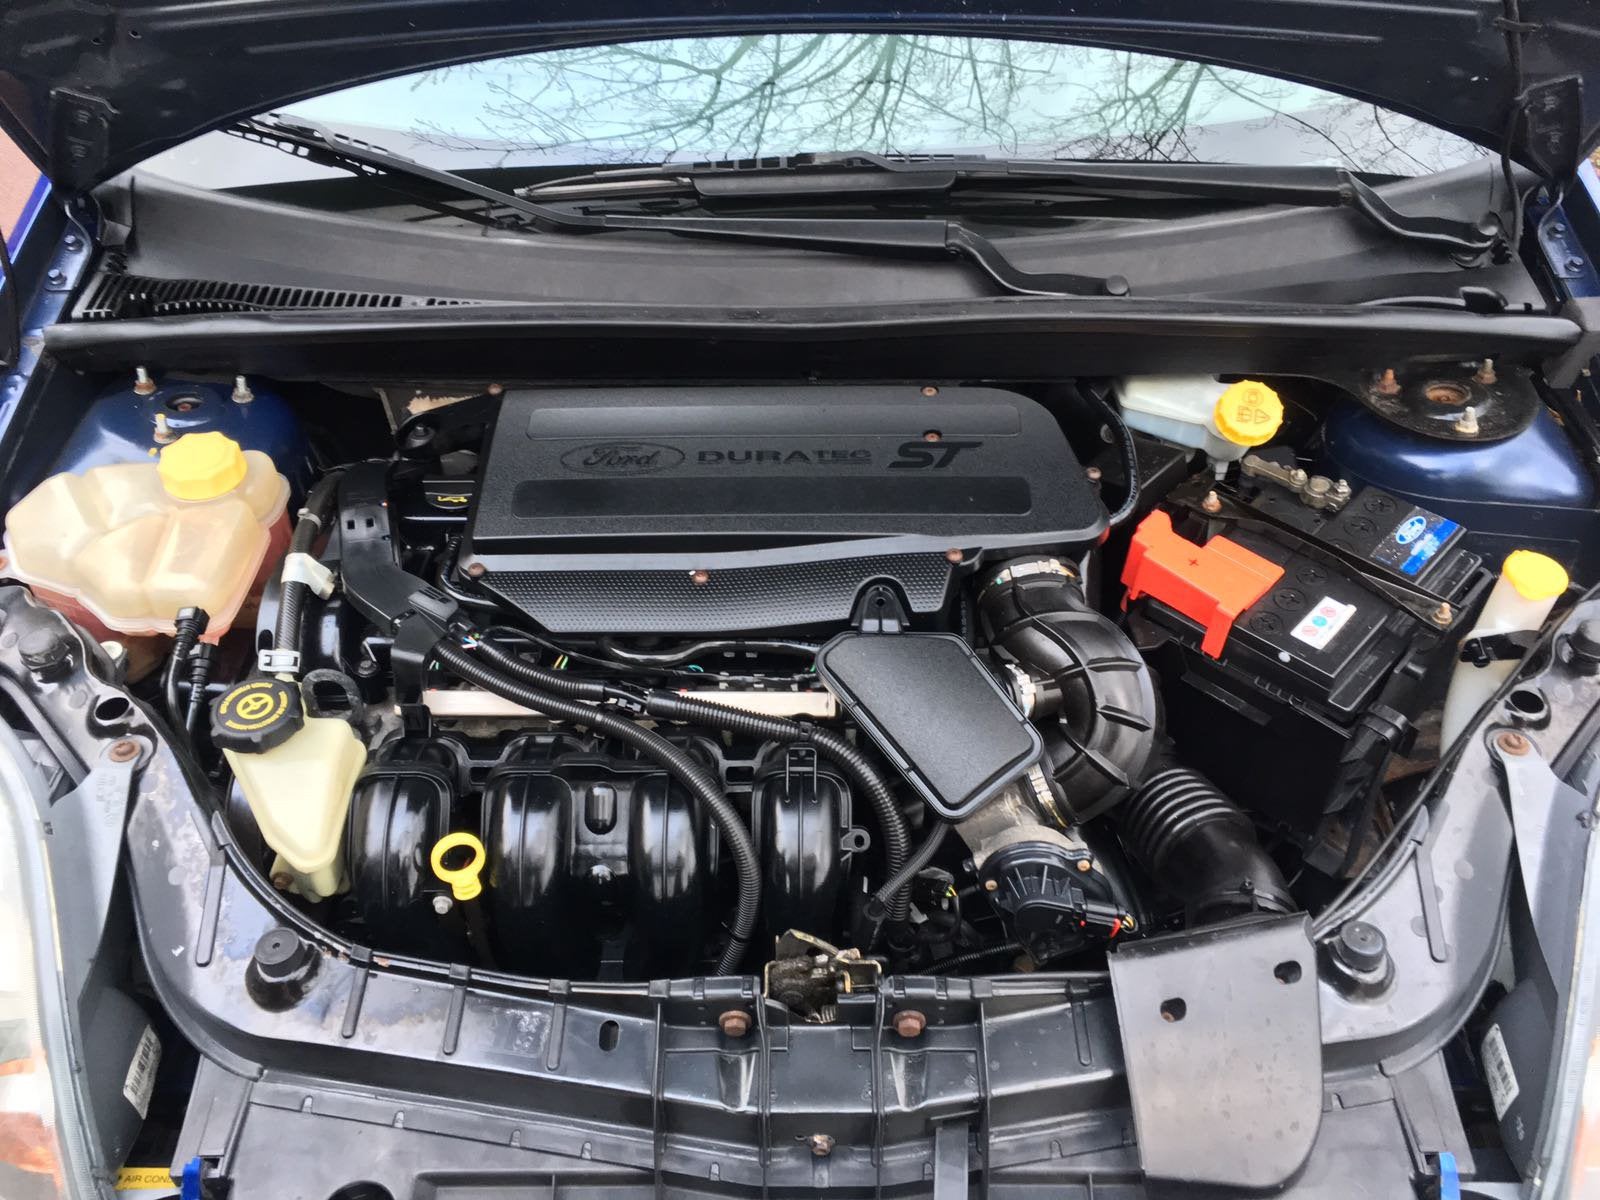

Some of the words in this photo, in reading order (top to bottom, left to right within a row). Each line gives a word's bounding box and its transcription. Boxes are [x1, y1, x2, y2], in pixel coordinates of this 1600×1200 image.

[582, 446, 661, 467] Ford
[887, 441, 983, 470] ST
[124, 1174, 142, 1183] AIR
